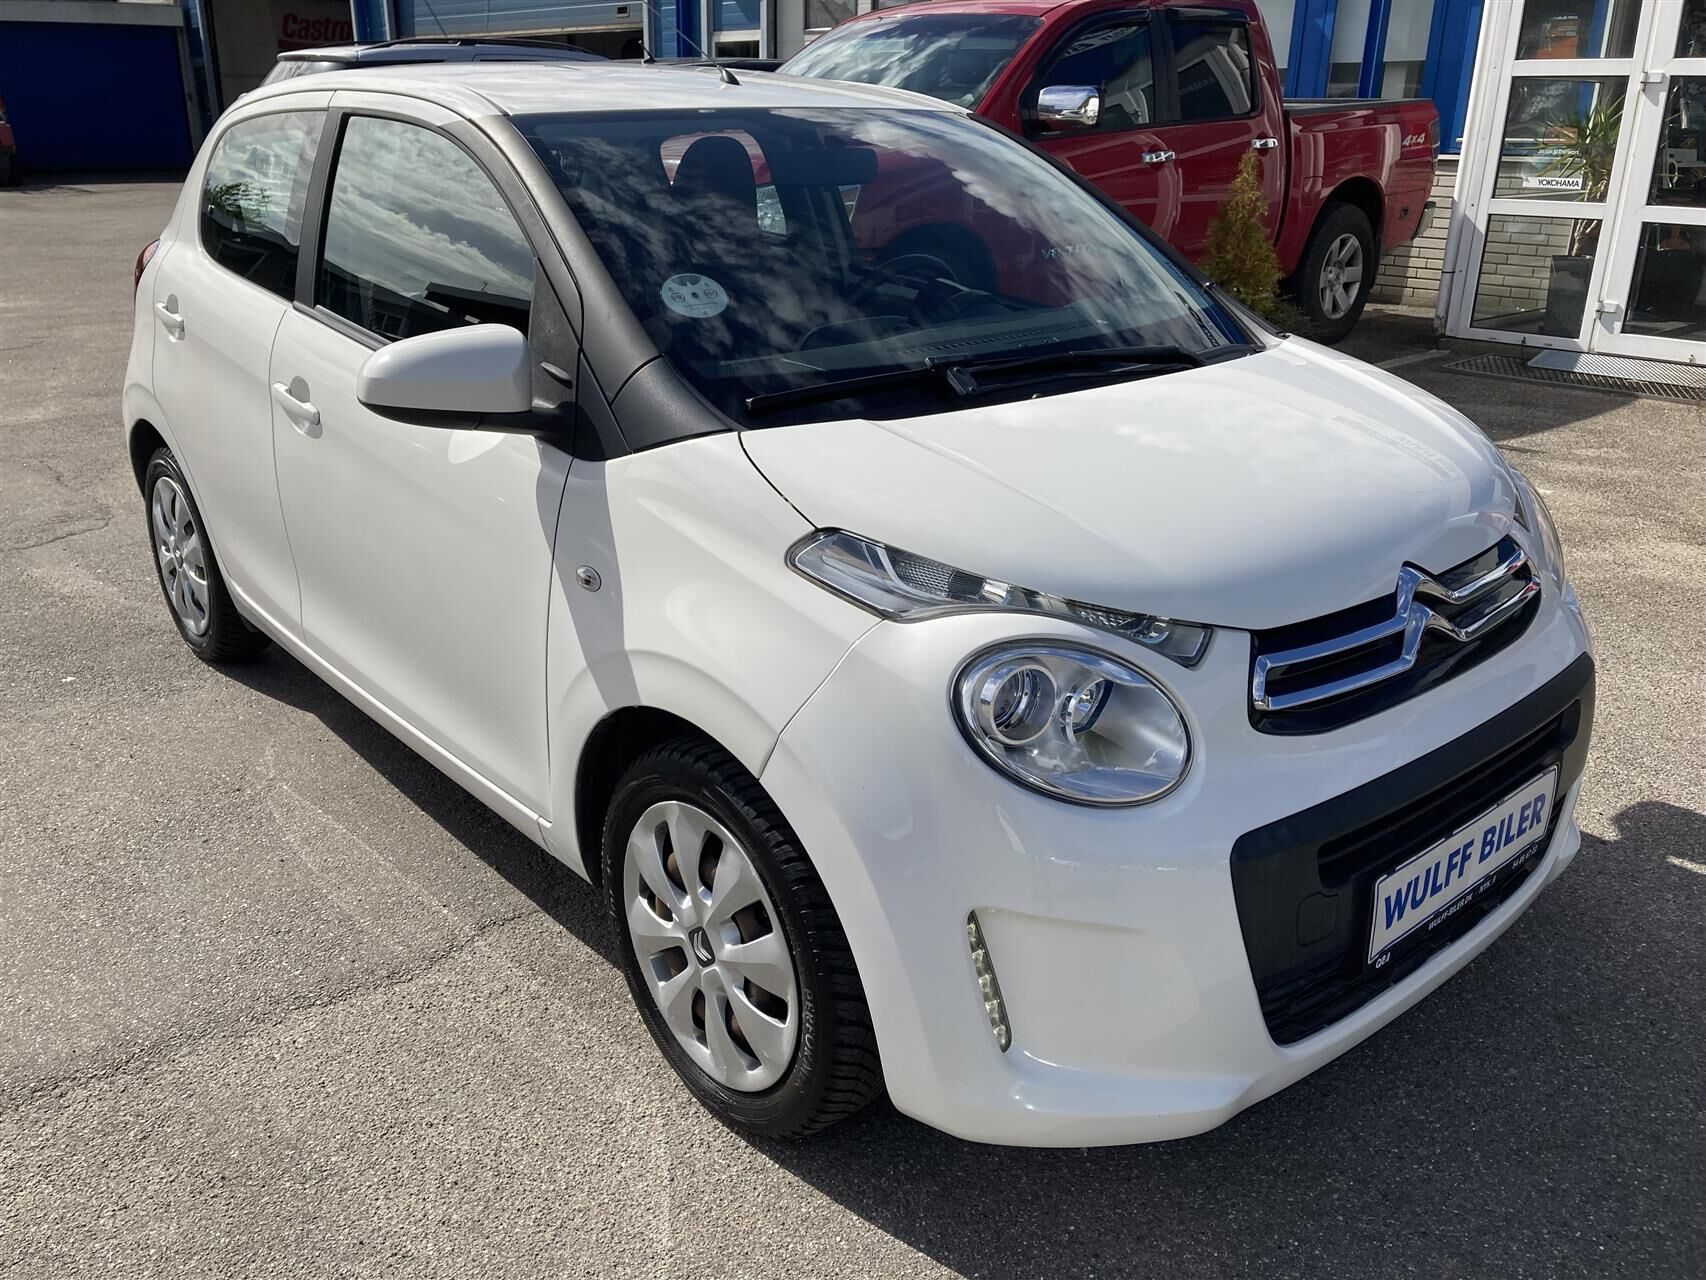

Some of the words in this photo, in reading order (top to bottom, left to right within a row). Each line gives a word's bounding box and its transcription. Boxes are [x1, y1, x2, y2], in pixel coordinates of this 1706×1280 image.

[1537, 178, 1580, 188] YOKOHAMA
[1384, 838, 1475, 930] WULFF
[1478, 792, 1546, 865] BILER
